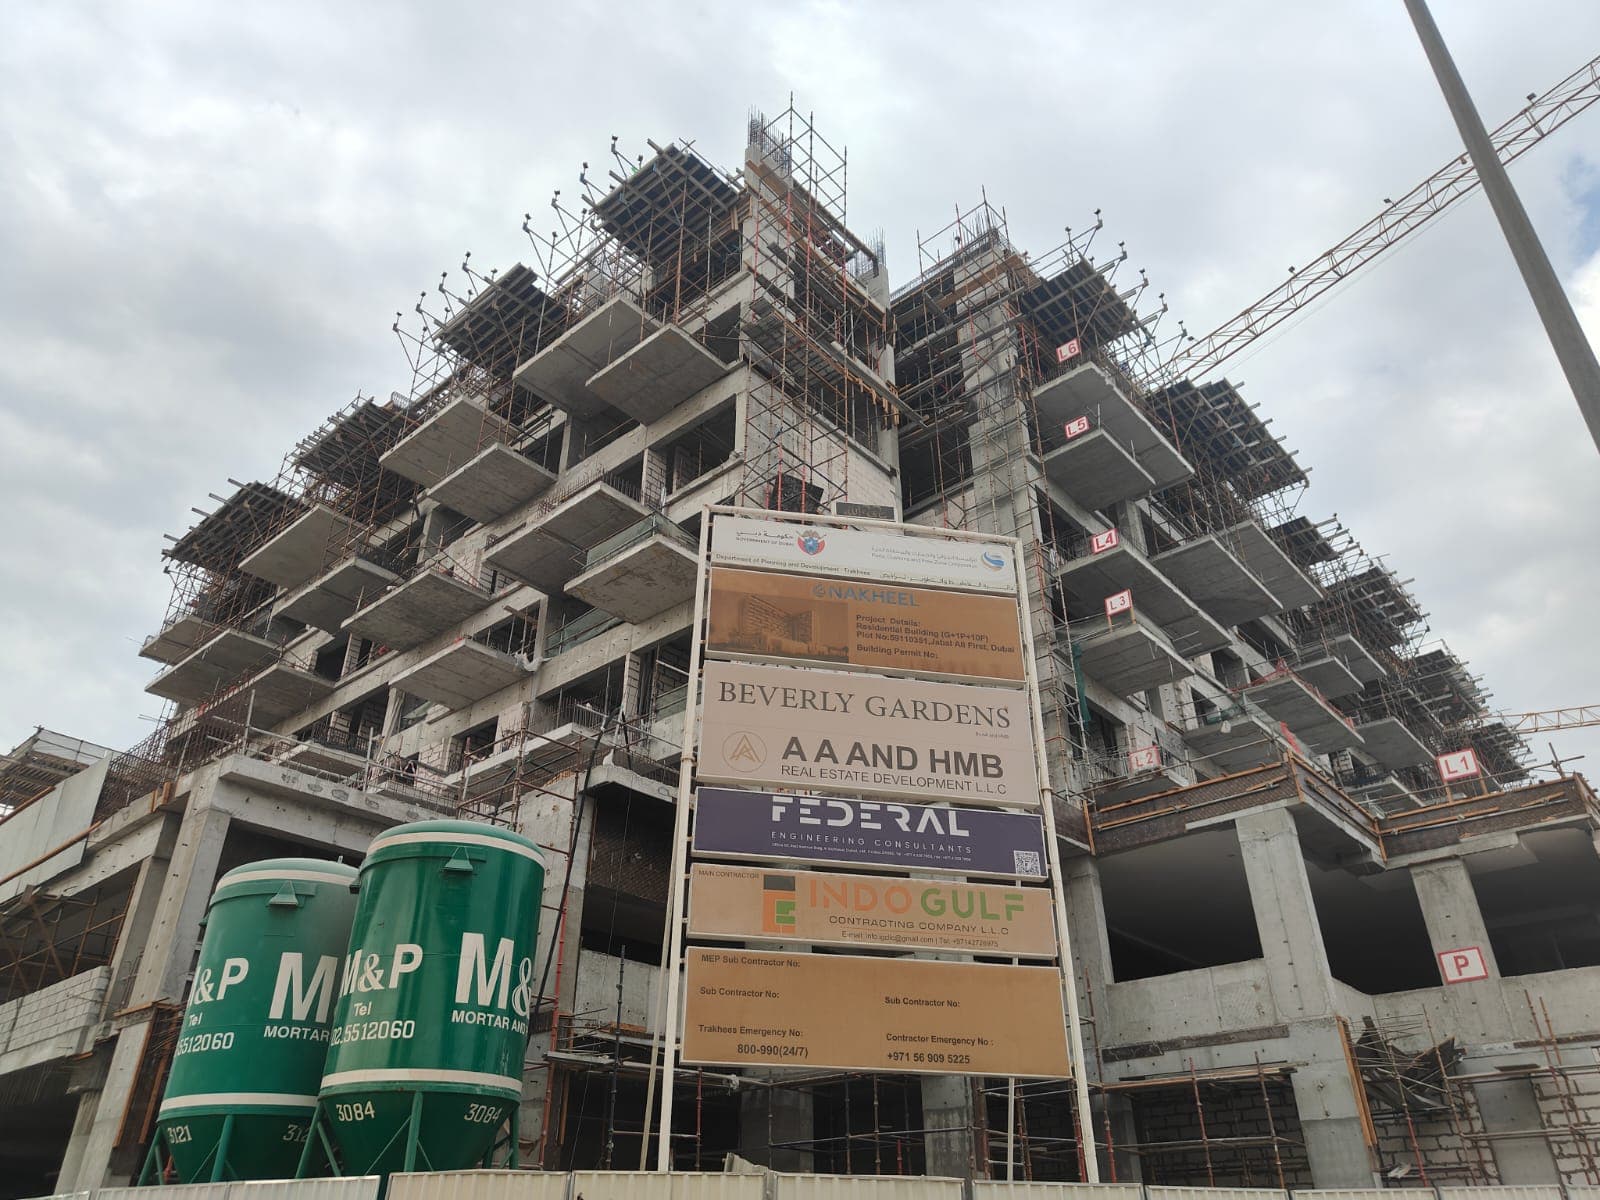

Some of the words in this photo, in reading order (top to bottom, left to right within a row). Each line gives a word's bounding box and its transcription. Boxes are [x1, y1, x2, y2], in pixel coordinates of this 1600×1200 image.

[1095, 532, 1114, 550] L4
[827, 584, 920, 607] NAKHEEL
[856, 614, 886, 624] Project
[856, 622, 903, 633] Residential
[905, 627, 939, 639] Building
[856, 631, 873, 639] Plot
[955, 640, 966, 648] Ali
[991, 644, 1015, 653] Dubai
[856, 644, 892, 656] Building
[894, 647, 922, 657] Permit
[718, 681, 855, 714] BEVERLY
[865, 695, 1011, 729] GARDENS
[929, 748, 1004, 779] HMB
[1444, 755, 1470, 775] L1
[781, 764, 816, 778] REAL
[820, 768, 869, 783] ESTATE
[873, 772, 973, 791] DEVELOPMENT
[771, 795, 970, 837] FEDERAL
[771, 831, 865, 846] ENGINEERING
[874, 839, 972, 855] CONSULTANTS
[698, 869, 714, 877] MAIN
[715, 870, 760, 880] CONTRACTOR
[829, 915, 915, 930] CONTRACTING
[918, 921, 977, 934] COMPANY
[701, 953, 720, 963] MEP
[722, 955, 738, 964] Sub
[741, 956, 785, 967] Contractor
[786, 959, 801, 968] No:
[1453, 954, 1470, 977] P
[700, 986, 717, 995] Sub
[719, 987, 763, 998] Contractor
[765, 990, 780, 999] No:
[353, 1001, 372, 1017] Tel
[885, 996, 901, 1005] Sub
[902, 997, 945, 1007] Contractor
[946, 999, 960, 1008] No:
[188, 1012, 203, 1027] Tel
[451, 1009, 509, 1031] MORTAR
[263, 1025, 331, 1043] MORTAR
[739, 1026, 787, 1038] Emergency
[788, 1028, 803, 1037] No:
[886, 1032, 929, 1043] Contractor
[931, 1035, 976, 1047] Emergency
[737, 1043, 809, 1059] 800-990(24/7)
[887, 1051, 910, 1062] +971
[913, 1052, 925, 1063] 56
[927, 1053, 945, 1064] 909
[947, 1054, 971, 1065] 5225
[336, 1100, 376, 1122] 3084
[464, 1102, 504, 1126] 3084
[167, 1124, 193, 1145] 3121
